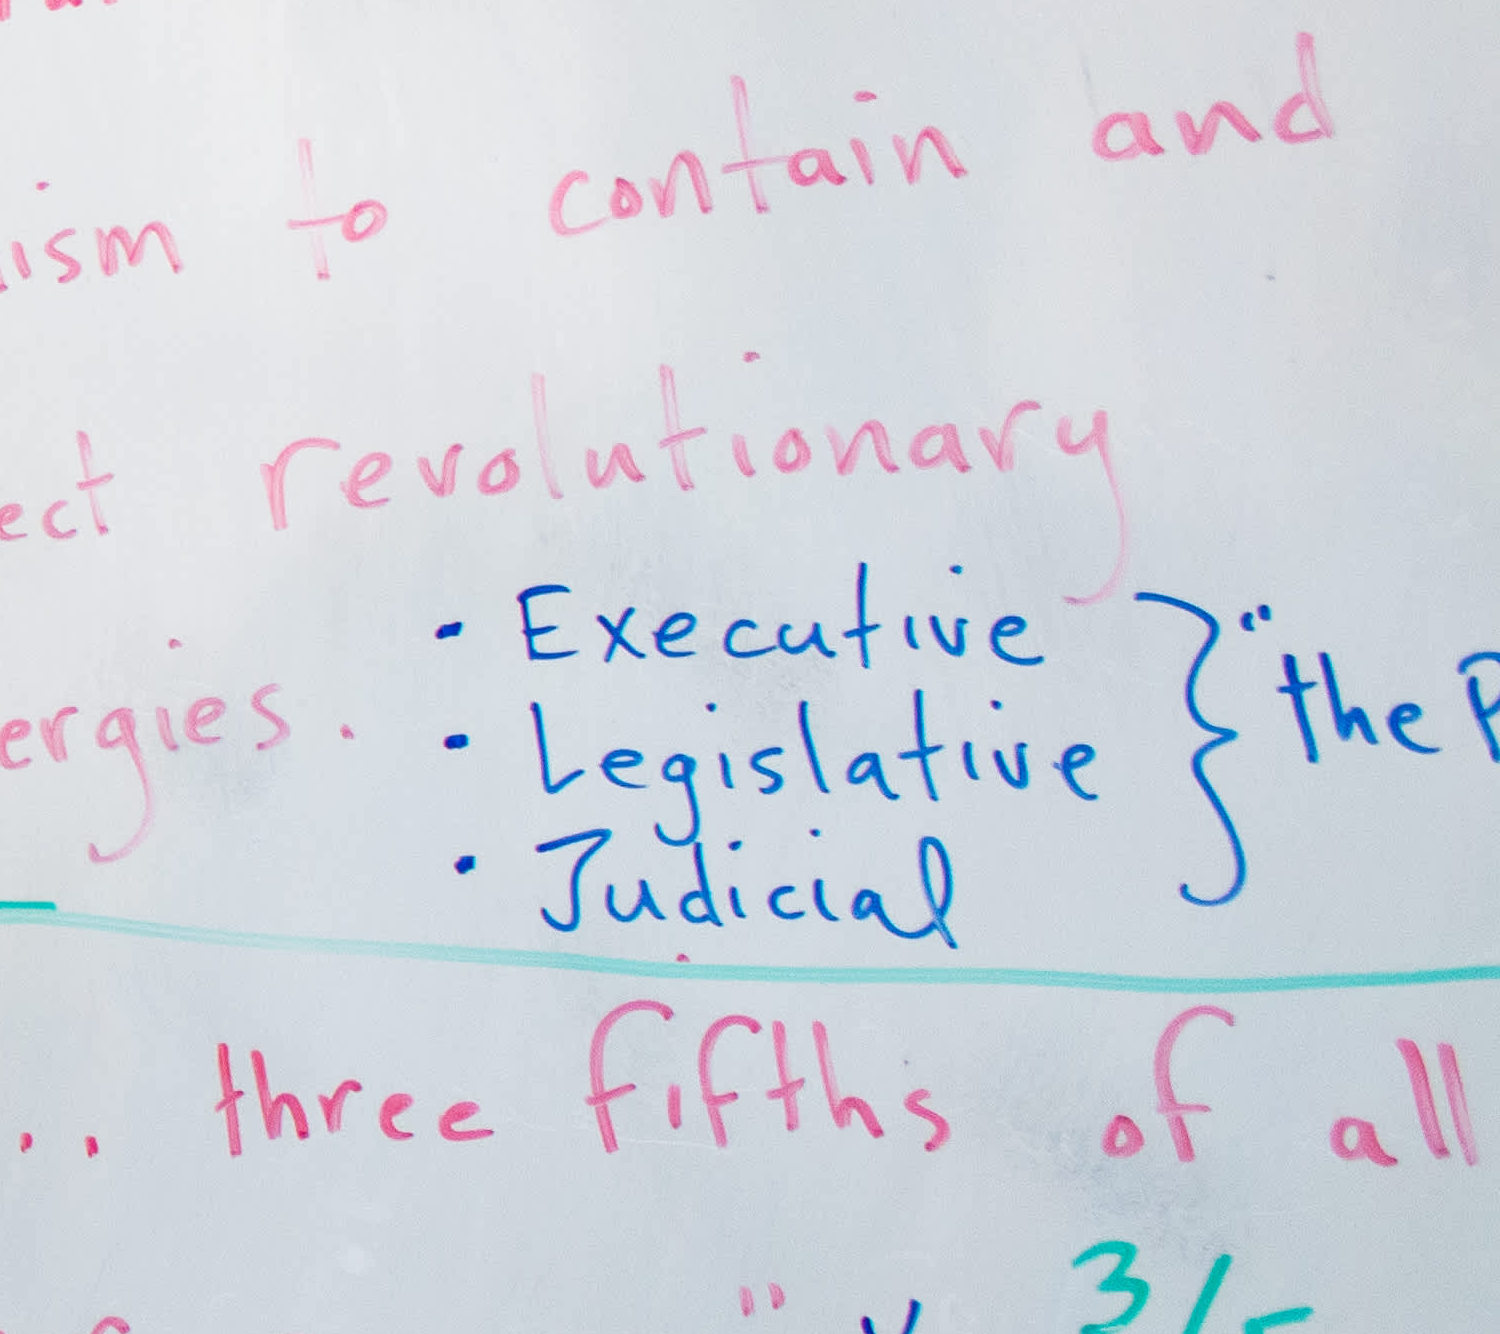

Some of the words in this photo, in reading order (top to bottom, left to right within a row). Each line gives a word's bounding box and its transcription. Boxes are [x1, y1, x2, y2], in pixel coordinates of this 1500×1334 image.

[289, 137, 390, 285] to
[549, 74, 971, 241] contain
[1092, 30, 1338, 163] and
[259, 352, 1136, 607] revolutionary
[515, 561, 1048, 668] Executive
[529, 700, 1102, 850] Legislative
[535, 827, 961, 952] Judicial
[214, 1042, 496, 1161] three
[584, 953, 952, 1155] fifths
[1102, 1005, 1238, 1165] of
[1329, 1036, 1479, 1168] all
